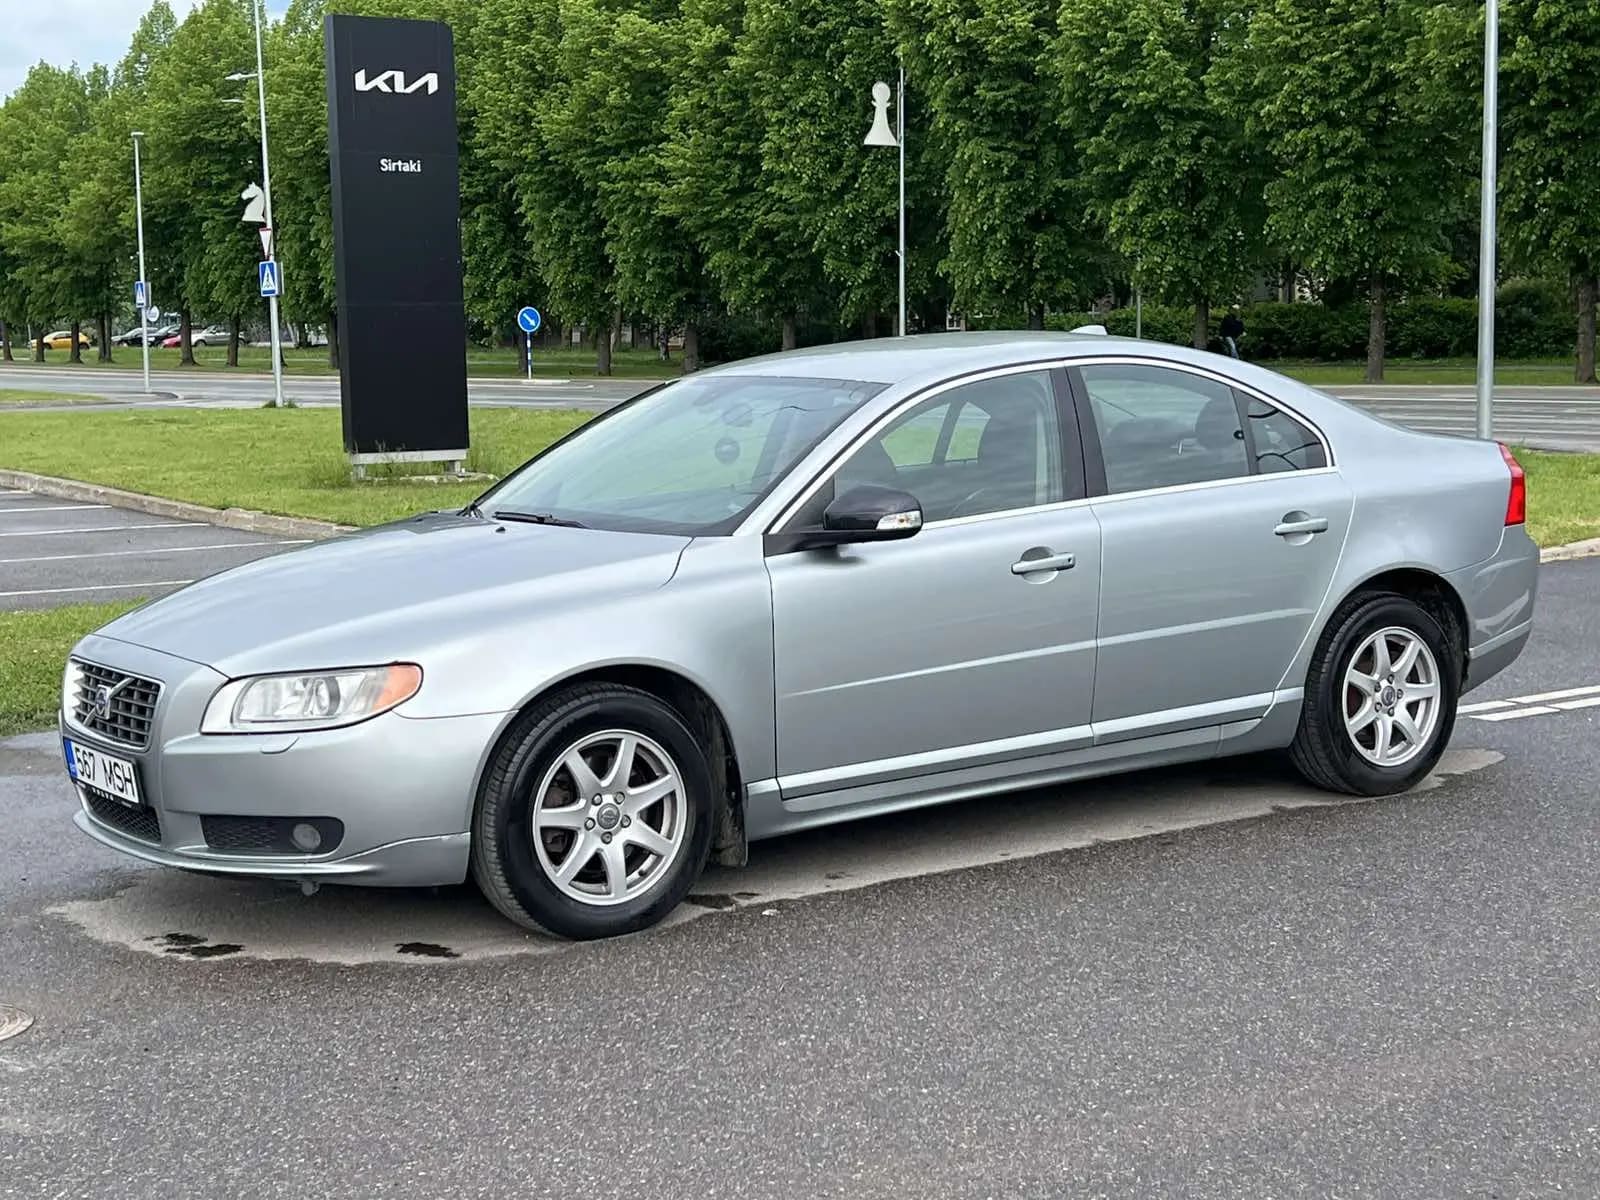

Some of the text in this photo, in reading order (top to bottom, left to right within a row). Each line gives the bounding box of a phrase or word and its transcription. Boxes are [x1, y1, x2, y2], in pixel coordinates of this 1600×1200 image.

[379, 158, 421, 172] Sirtaki
[75, 746, 135, 798] 567 MSH
